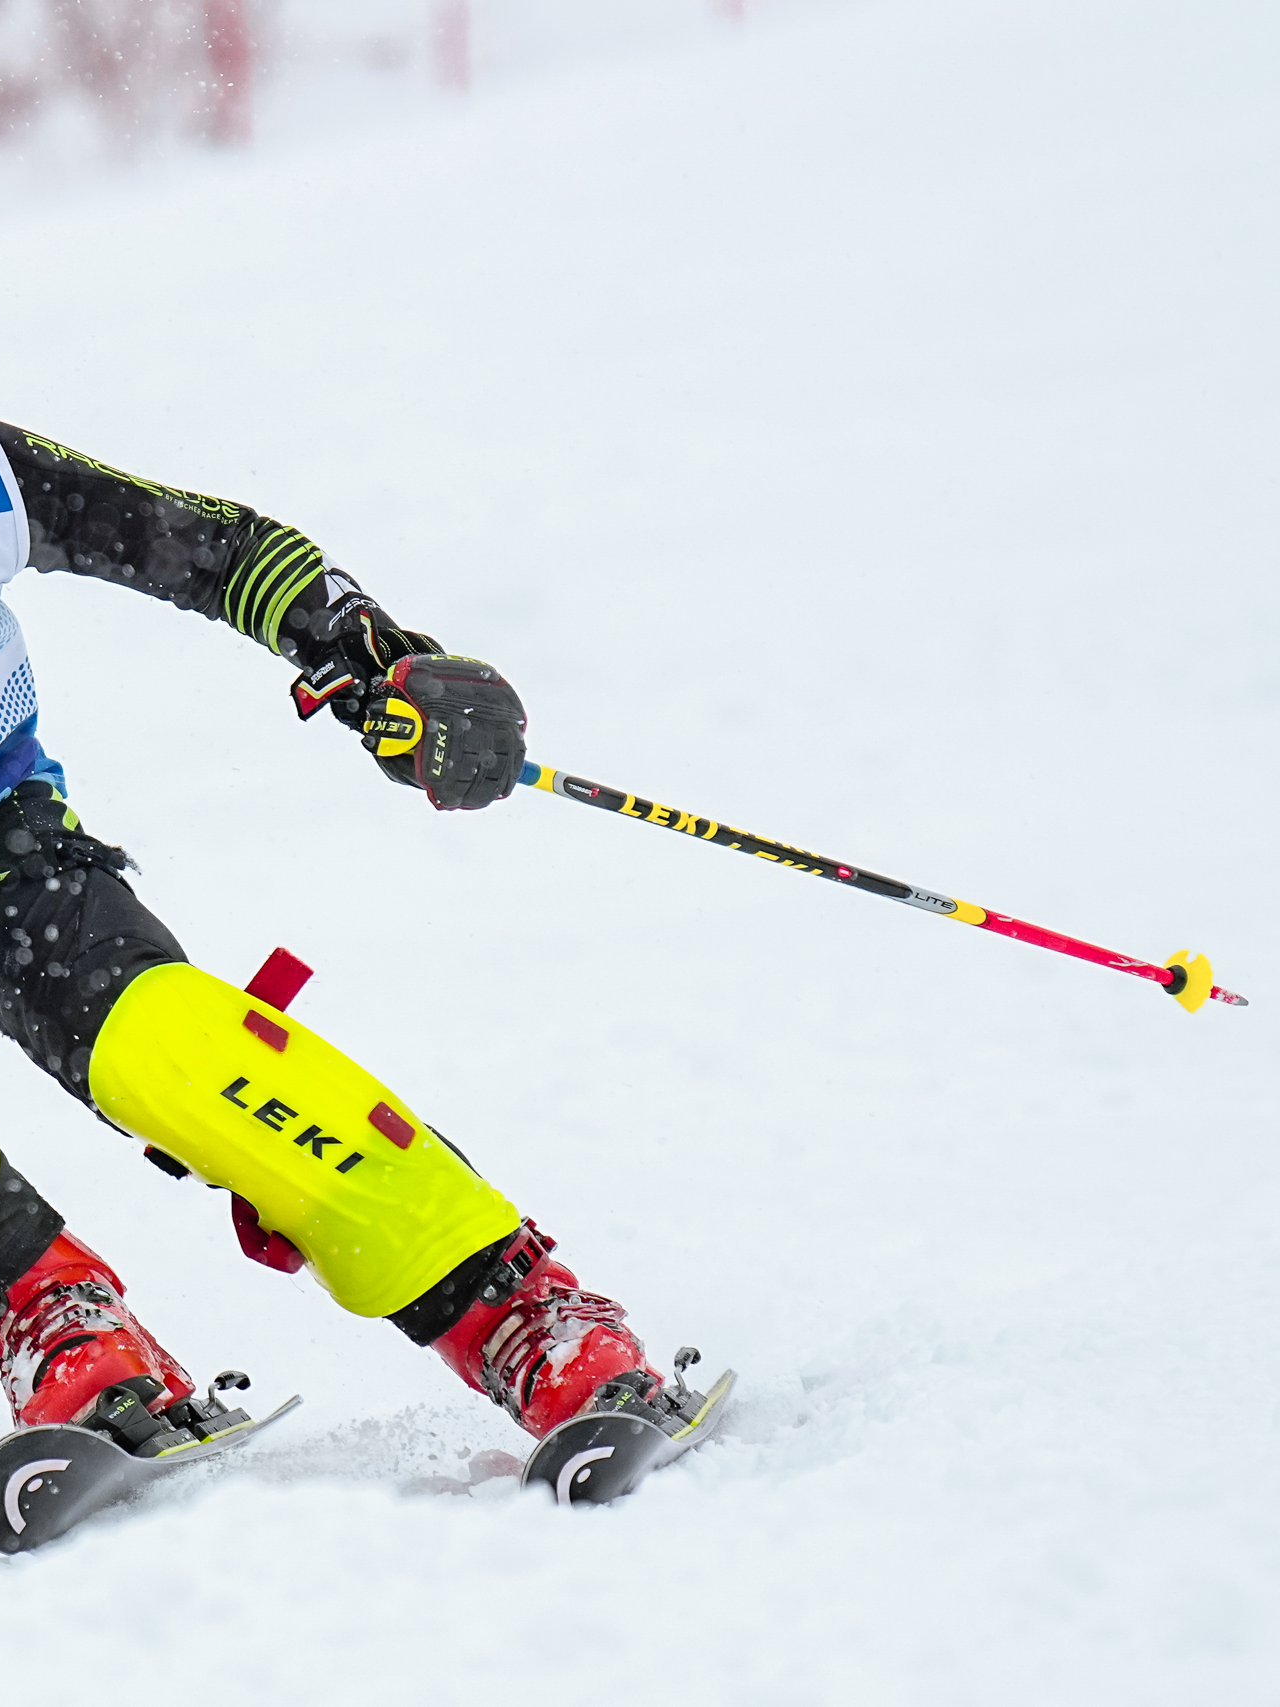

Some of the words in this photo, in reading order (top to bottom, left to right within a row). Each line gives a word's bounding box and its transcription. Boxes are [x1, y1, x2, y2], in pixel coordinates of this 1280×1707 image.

[174, 498, 202, 515] FISCHER
[201, 511, 221, 520] RACE
[369, 719, 413, 734] LEKI
[432, 722, 448, 776] LEKI
[618, 793, 719, 840] LEKI
[914, 892, 954, 911] LITE
[220, 1076, 365, 1174] LEKI
